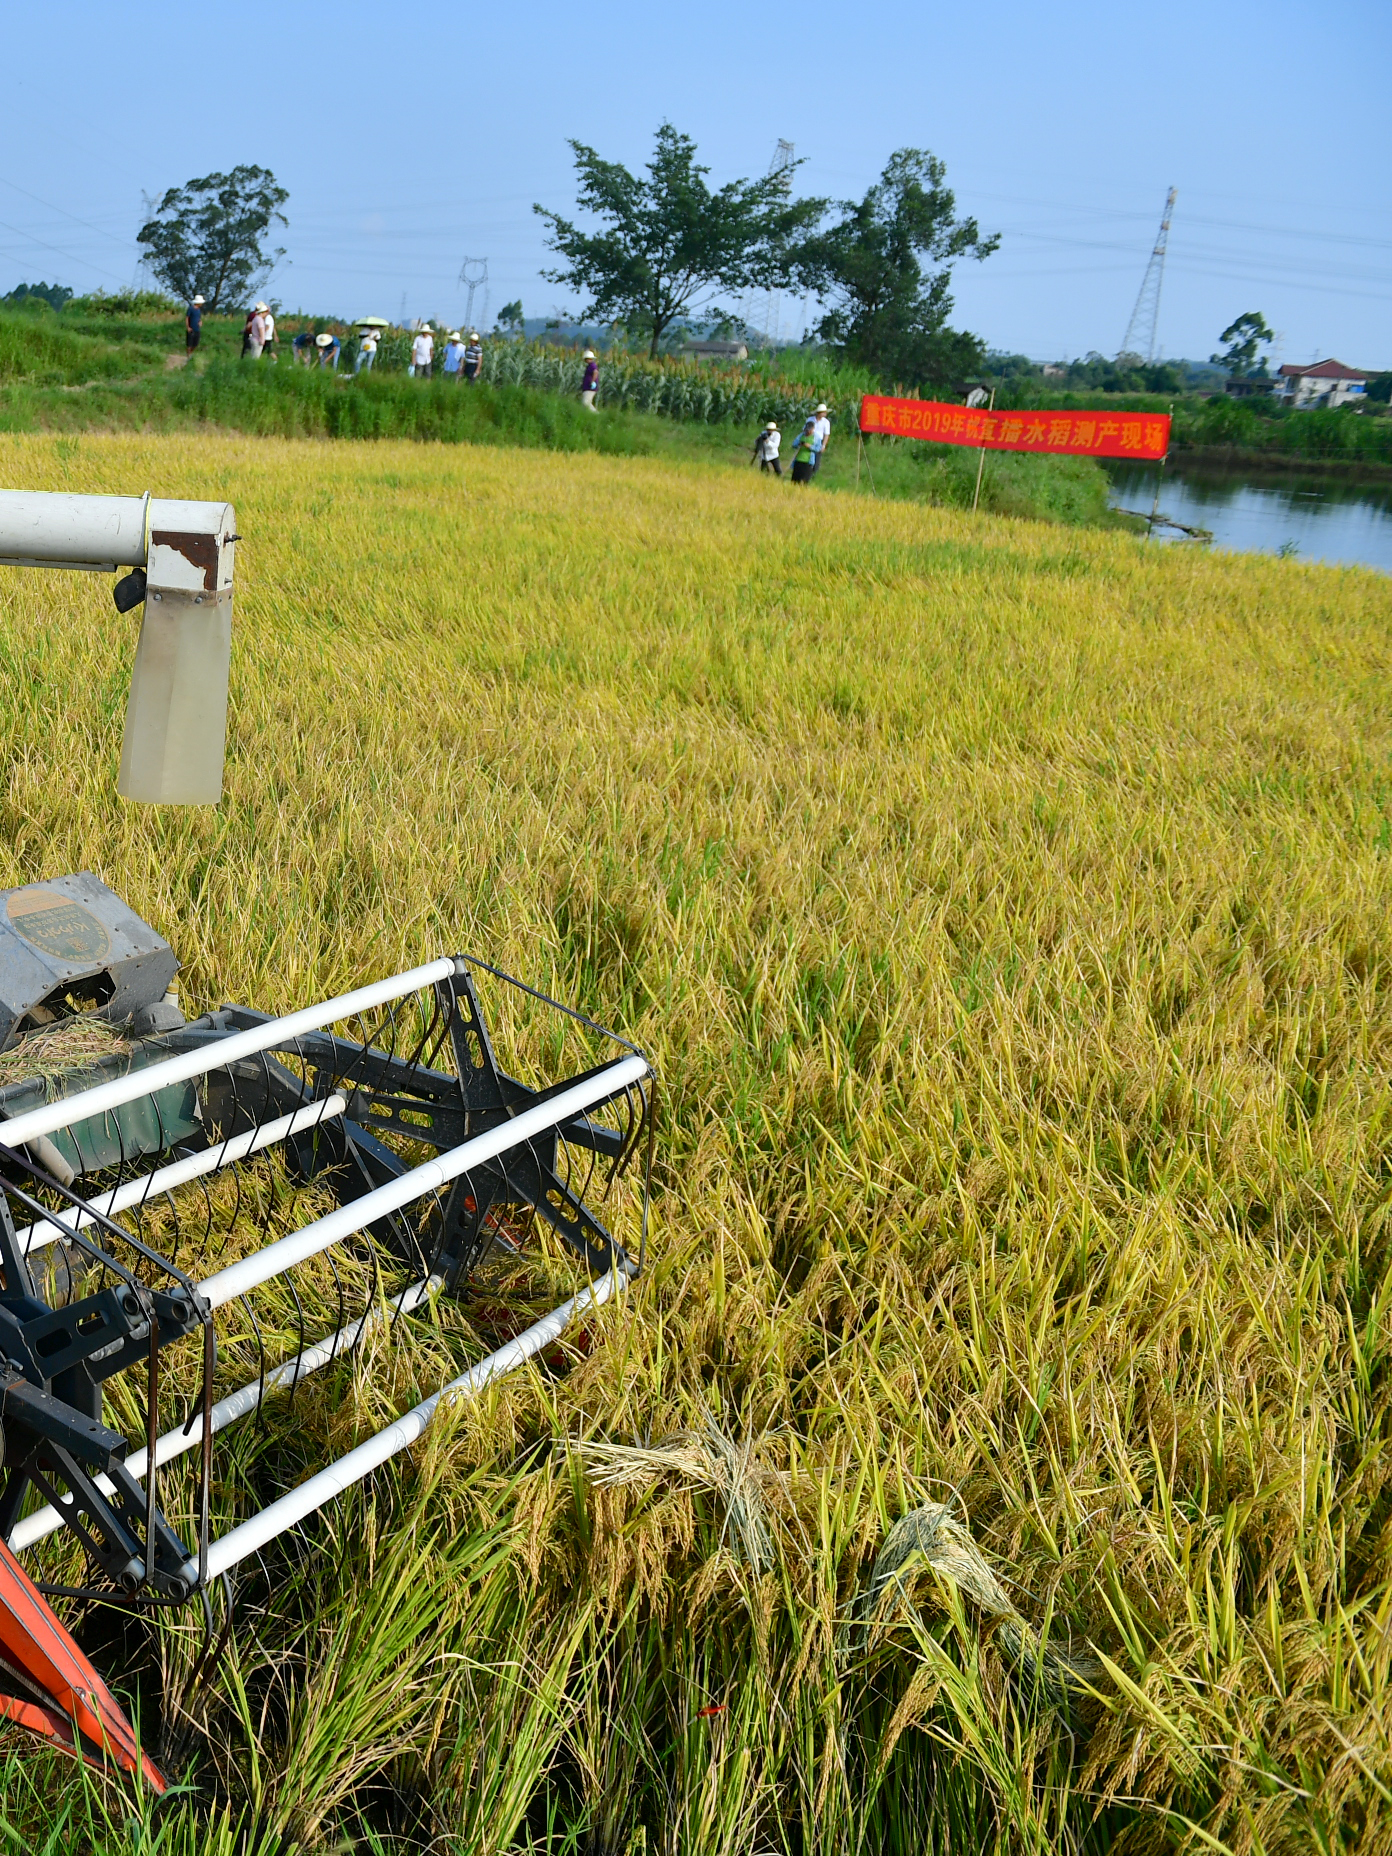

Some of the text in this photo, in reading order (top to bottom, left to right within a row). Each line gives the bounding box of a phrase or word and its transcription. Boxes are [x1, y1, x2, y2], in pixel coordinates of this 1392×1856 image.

[865, 401, 1164, 451] 重庆市2019年机直播水稻测产现场
[37, 921, 91, 939] Kubota
